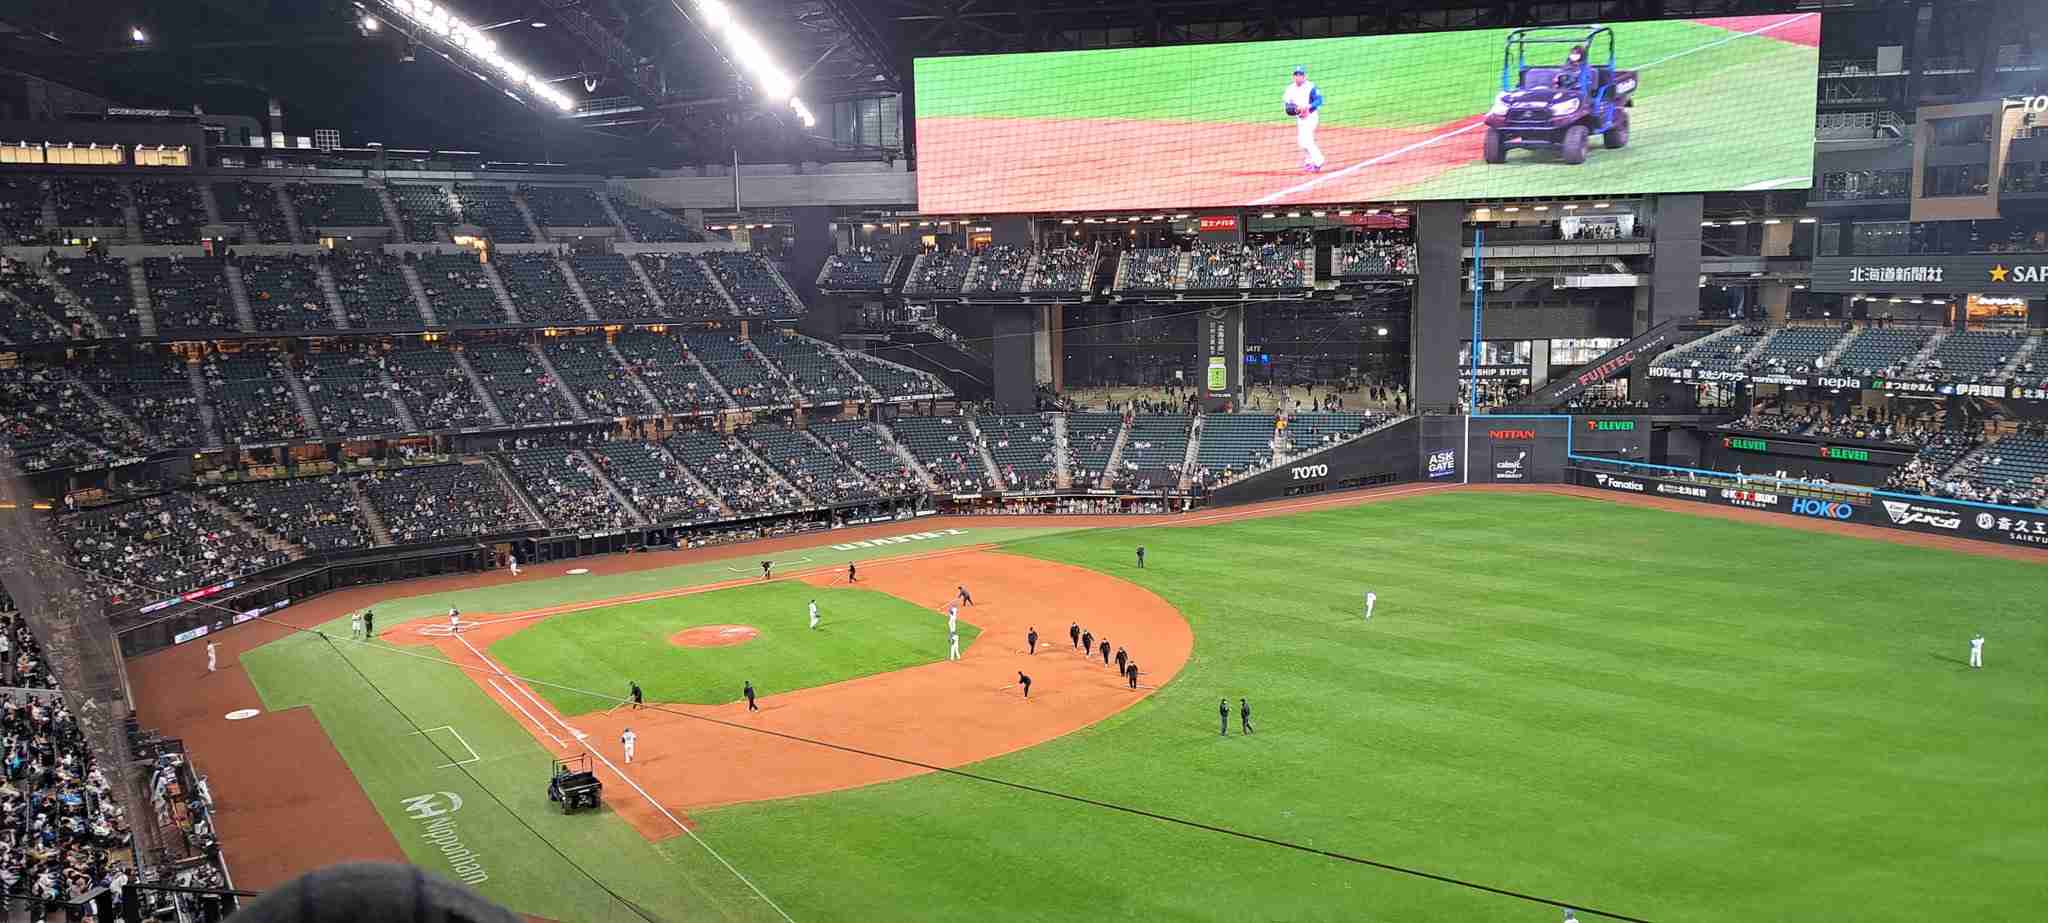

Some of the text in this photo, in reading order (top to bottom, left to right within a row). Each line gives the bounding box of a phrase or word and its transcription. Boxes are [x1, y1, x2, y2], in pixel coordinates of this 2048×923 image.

[1850, 266, 1943, 282] 北海道新聞社
[1578, 350, 1635, 386] FUJITEC
[1818, 375, 1860, 389] nepia
[1429, 451, 1455, 464] ASK
[1291, 464, 1328, 480] TOTO
[1428, 461, 1455, 472] GATE
[1608, 478, 1644, 492] Fanatics
[1792, 498, 1852, 519] HOKKO
[421, 816, 489, 886] Nipponham
